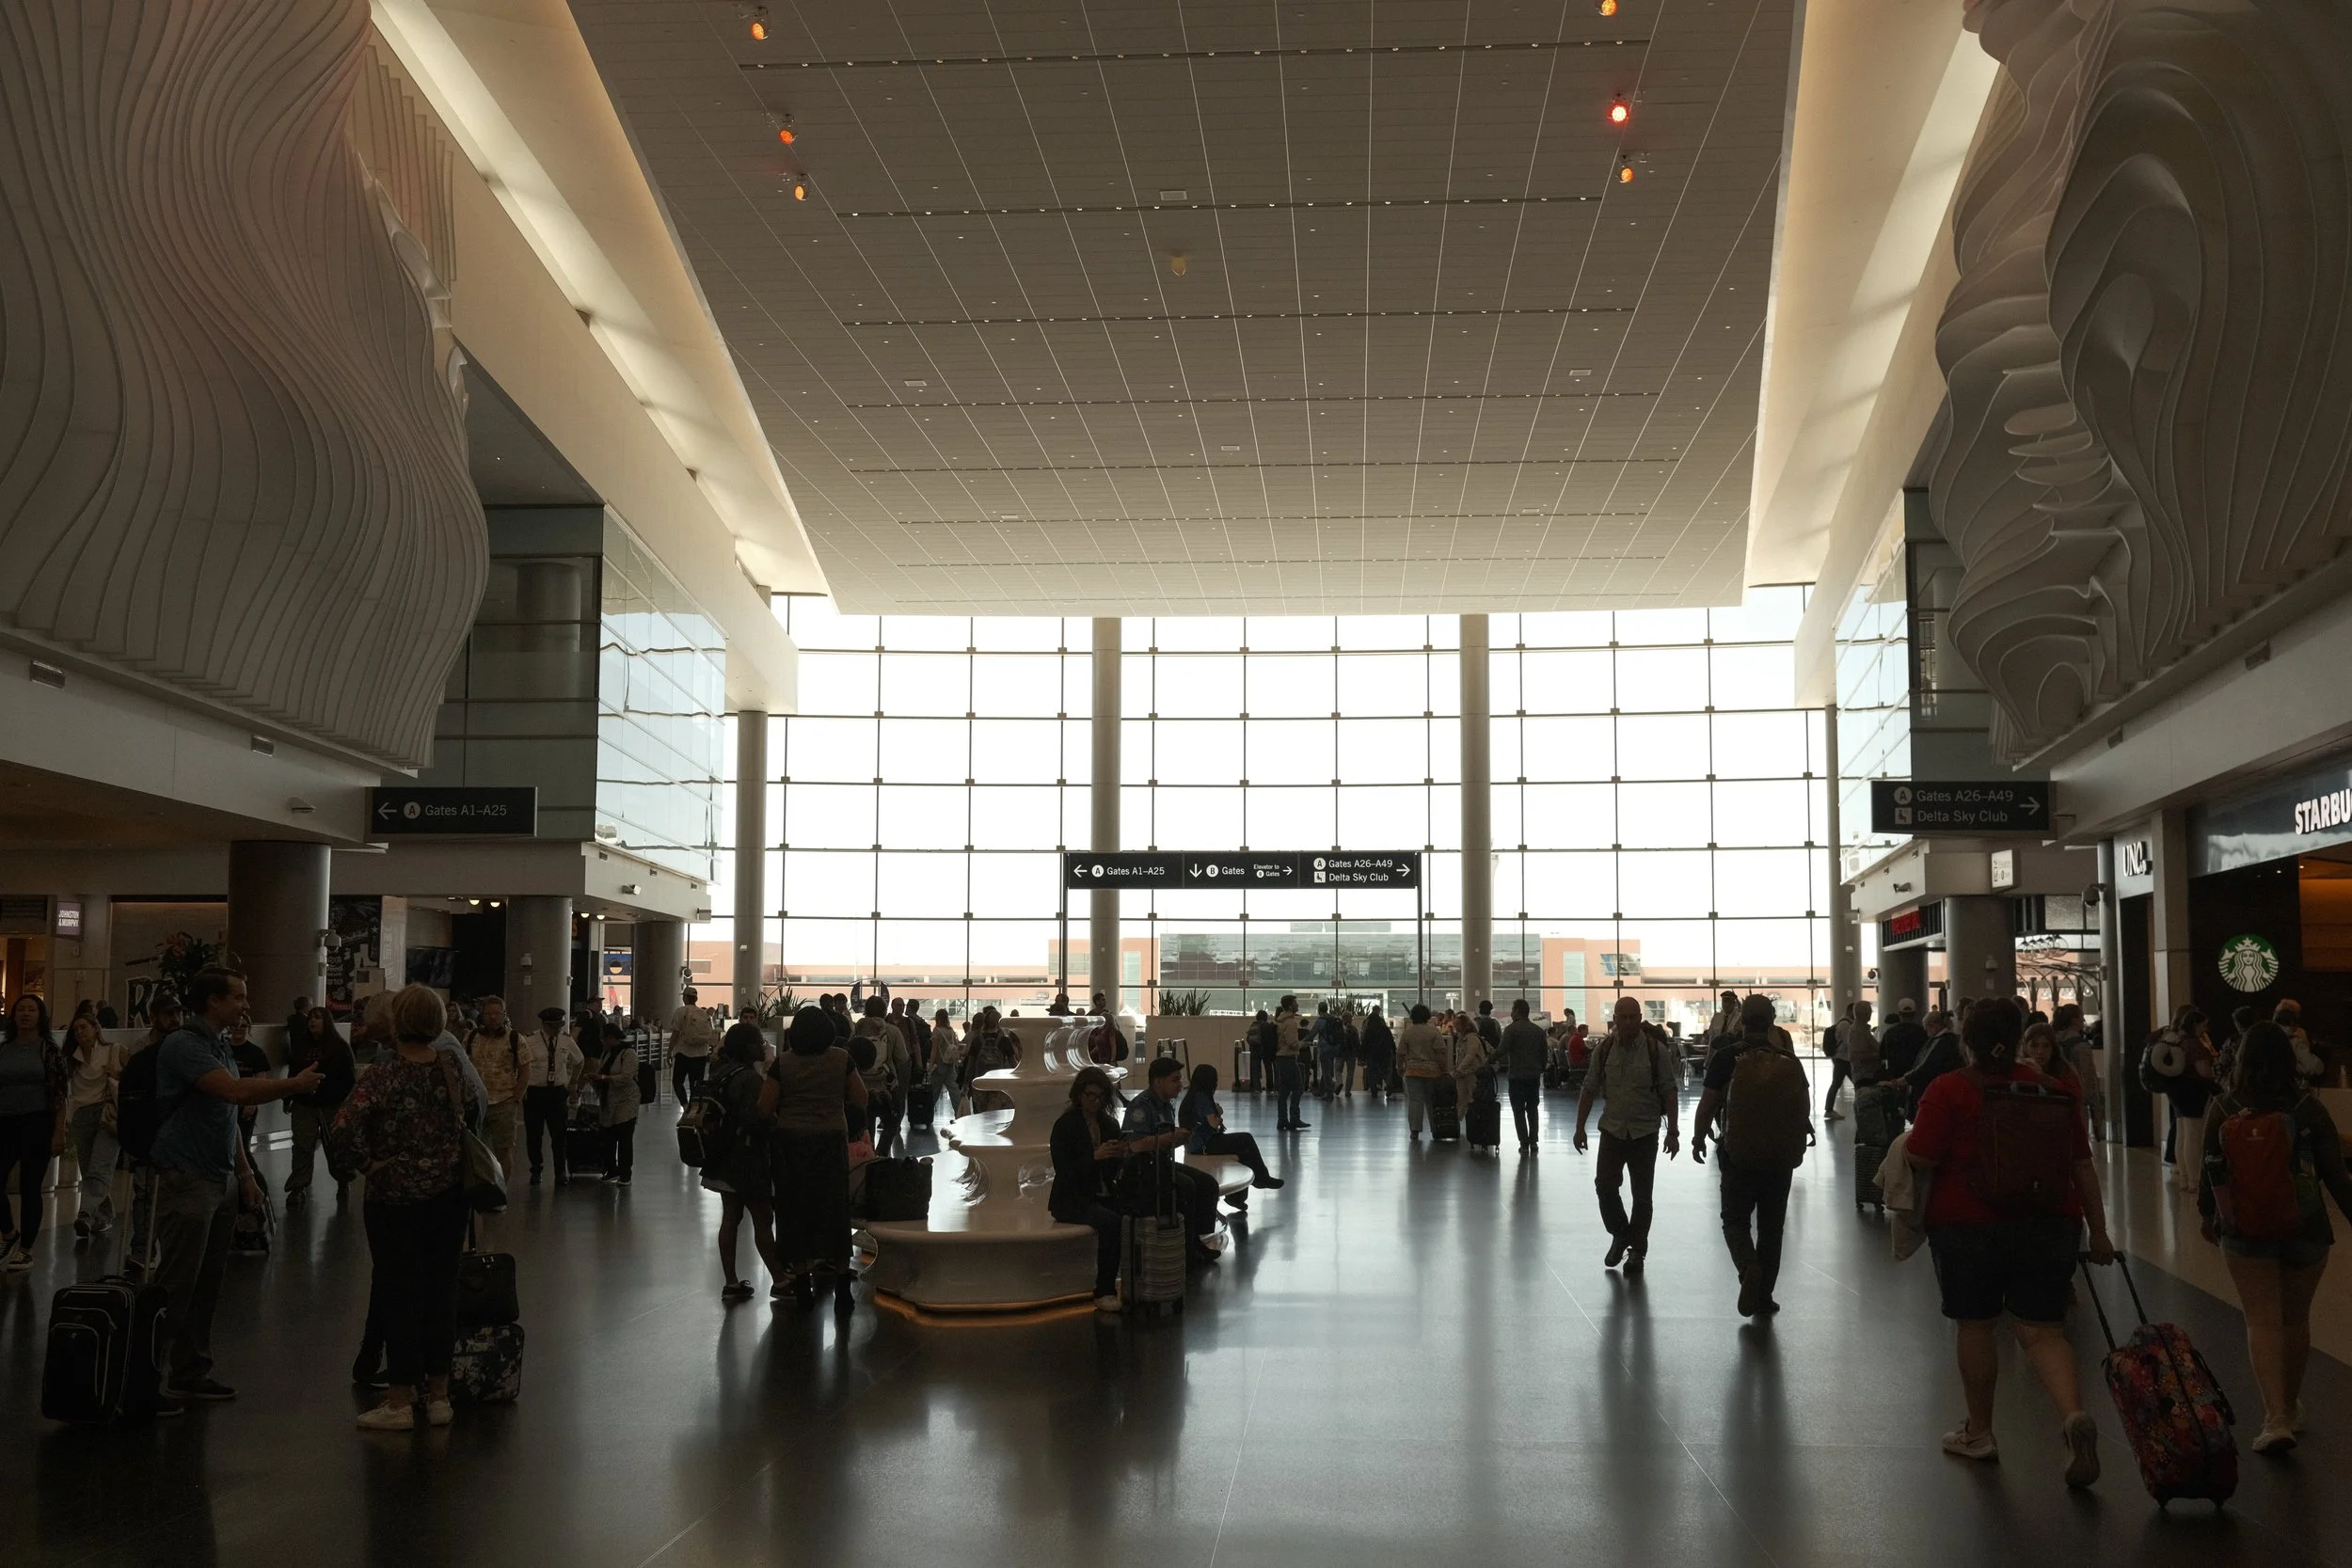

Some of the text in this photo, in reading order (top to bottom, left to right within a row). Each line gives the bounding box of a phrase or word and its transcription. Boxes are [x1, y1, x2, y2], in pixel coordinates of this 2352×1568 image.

[1916, 790, 1951, 802] Gates
[425, 804, 457, 816] Gates
[2296, 788, 2352, 835] STARBU
[1917, 810, 2009, 825] Delta Sky Club
[1328, 860, 1352, 868] Gates
[1106, 866, 1130, 876] Gates
[1221, 866, 1245, 876] Gates
[1328, 873, 1389, 883] Delta Sky Club
